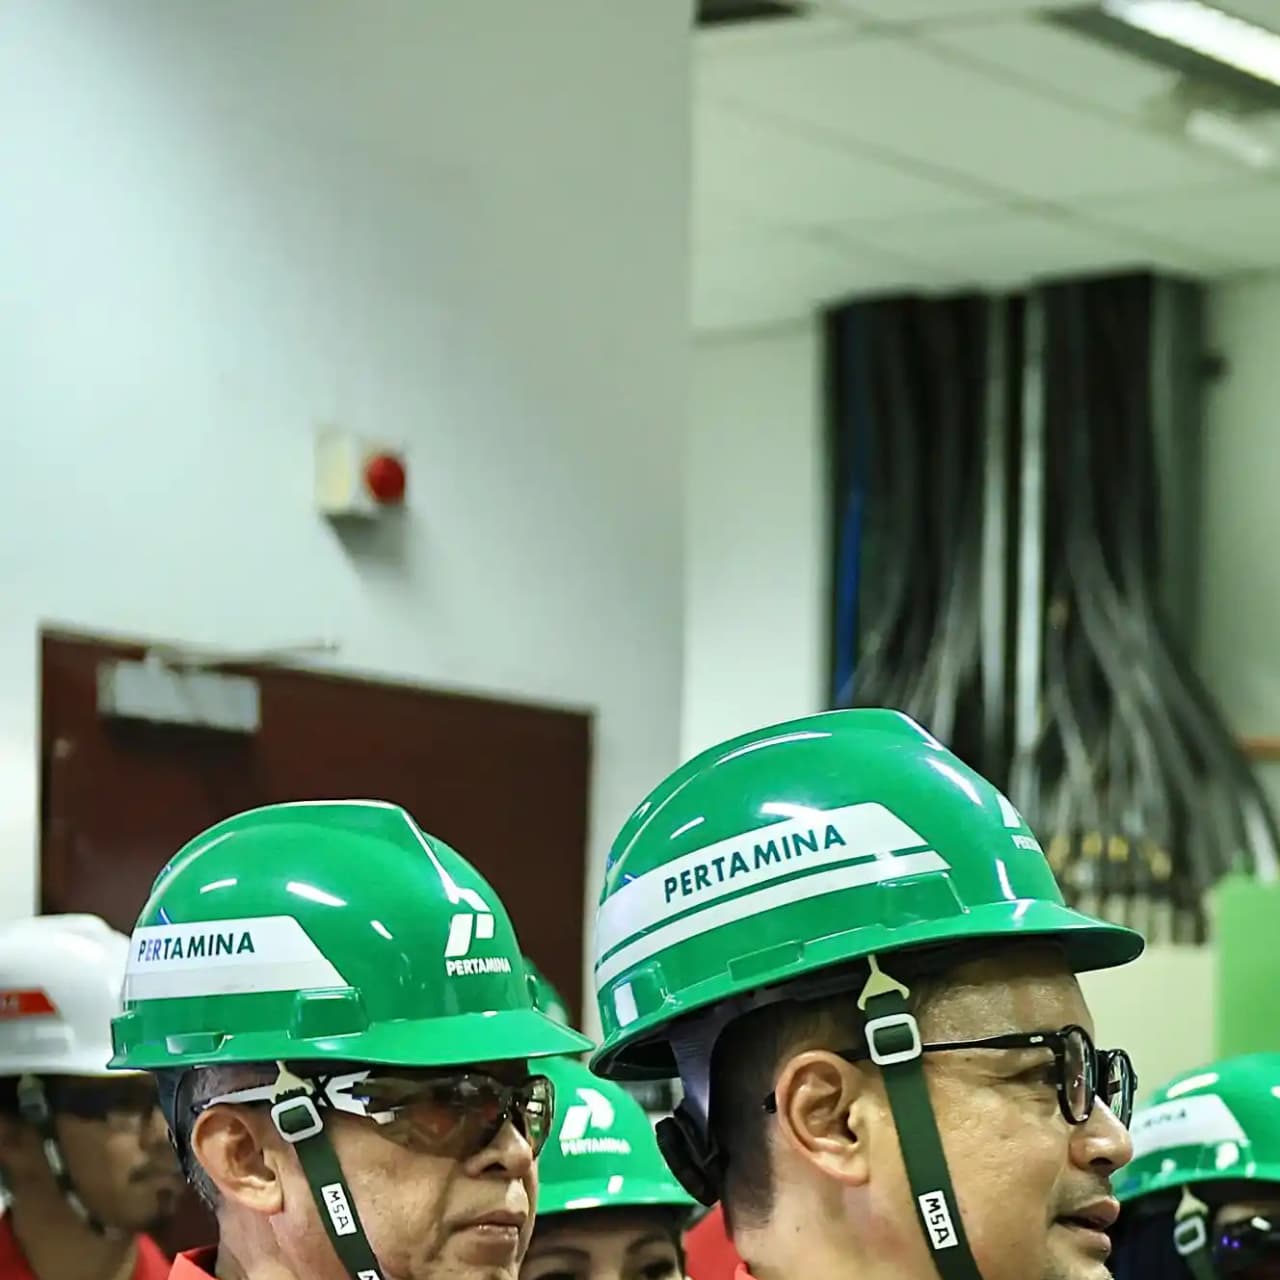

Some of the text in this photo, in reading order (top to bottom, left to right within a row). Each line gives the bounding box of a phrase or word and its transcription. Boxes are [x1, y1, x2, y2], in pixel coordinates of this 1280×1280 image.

[664, 824, 847, 904] PERTAMINA
[137, 931, 255, 963] PERTAMINA
[445, 956, 513, 977] PERTAMINA
[327, 1188, 350, 1231] MSA
[925, 1197, 950, 1245] MSA
